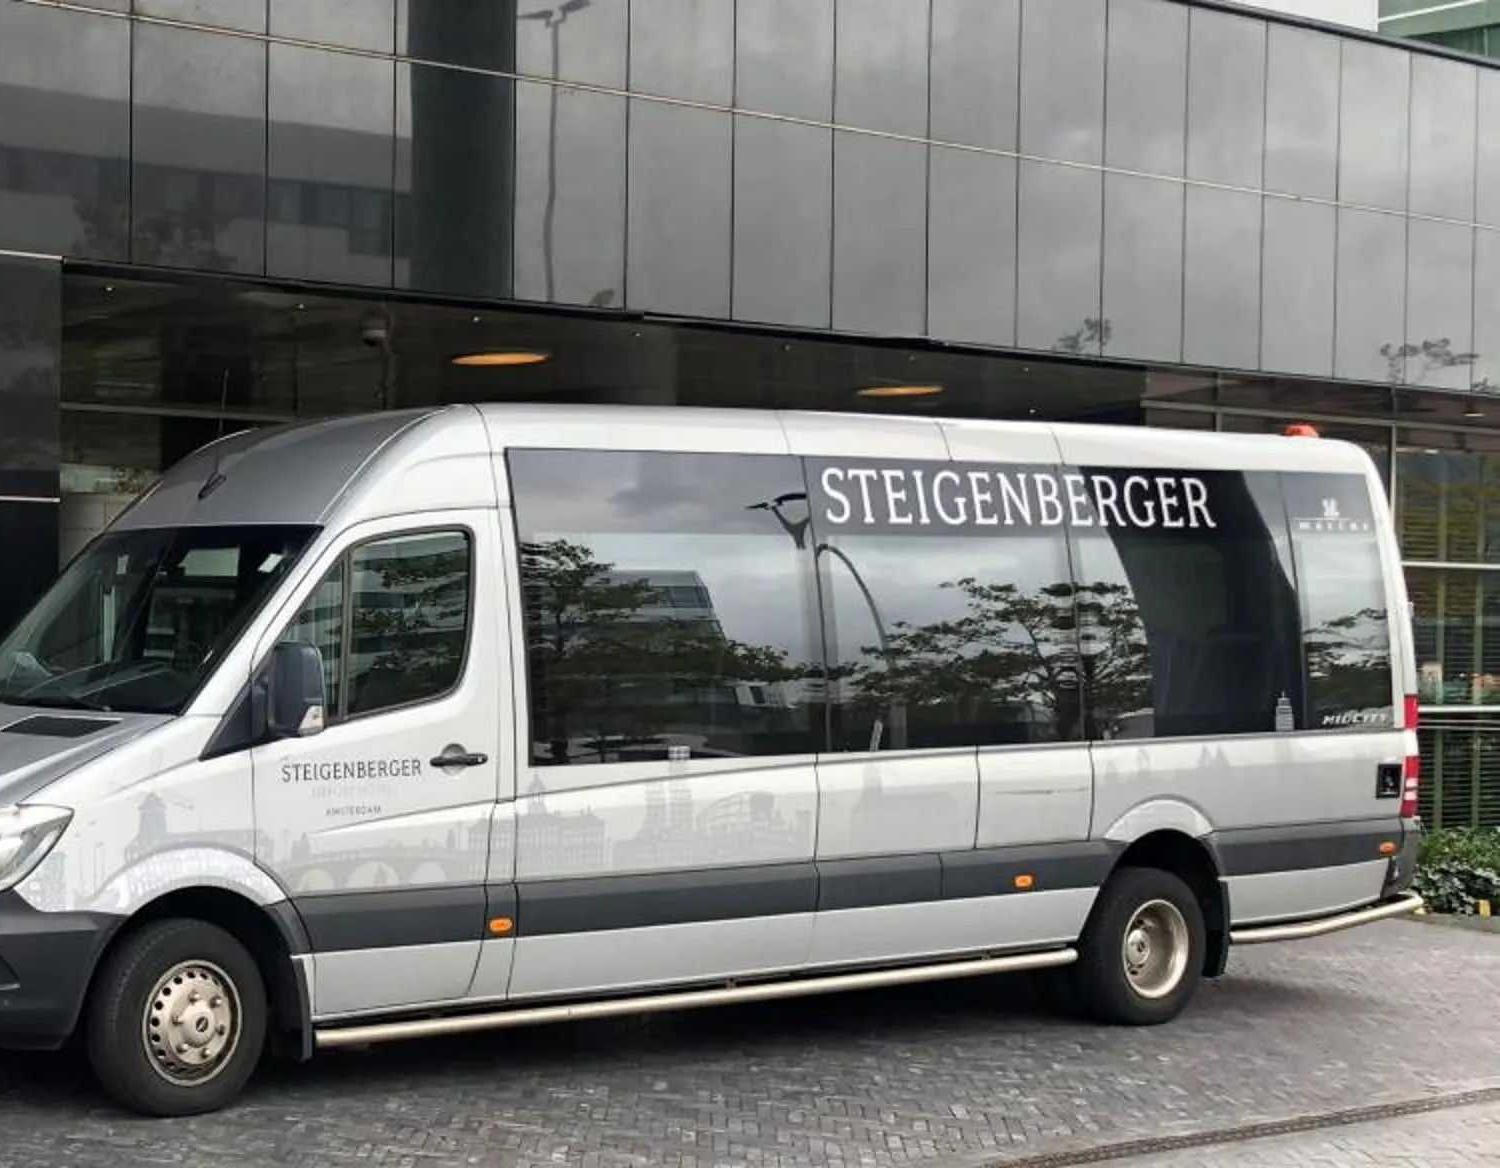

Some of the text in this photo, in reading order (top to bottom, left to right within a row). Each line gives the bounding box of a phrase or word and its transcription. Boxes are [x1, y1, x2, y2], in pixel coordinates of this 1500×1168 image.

[820, 466, 1217, 528] STEIGENBERGER
[281, 759, 422, 783] STEIGENBERGER
[325, 805, 382, 817] AMSTERDAM
